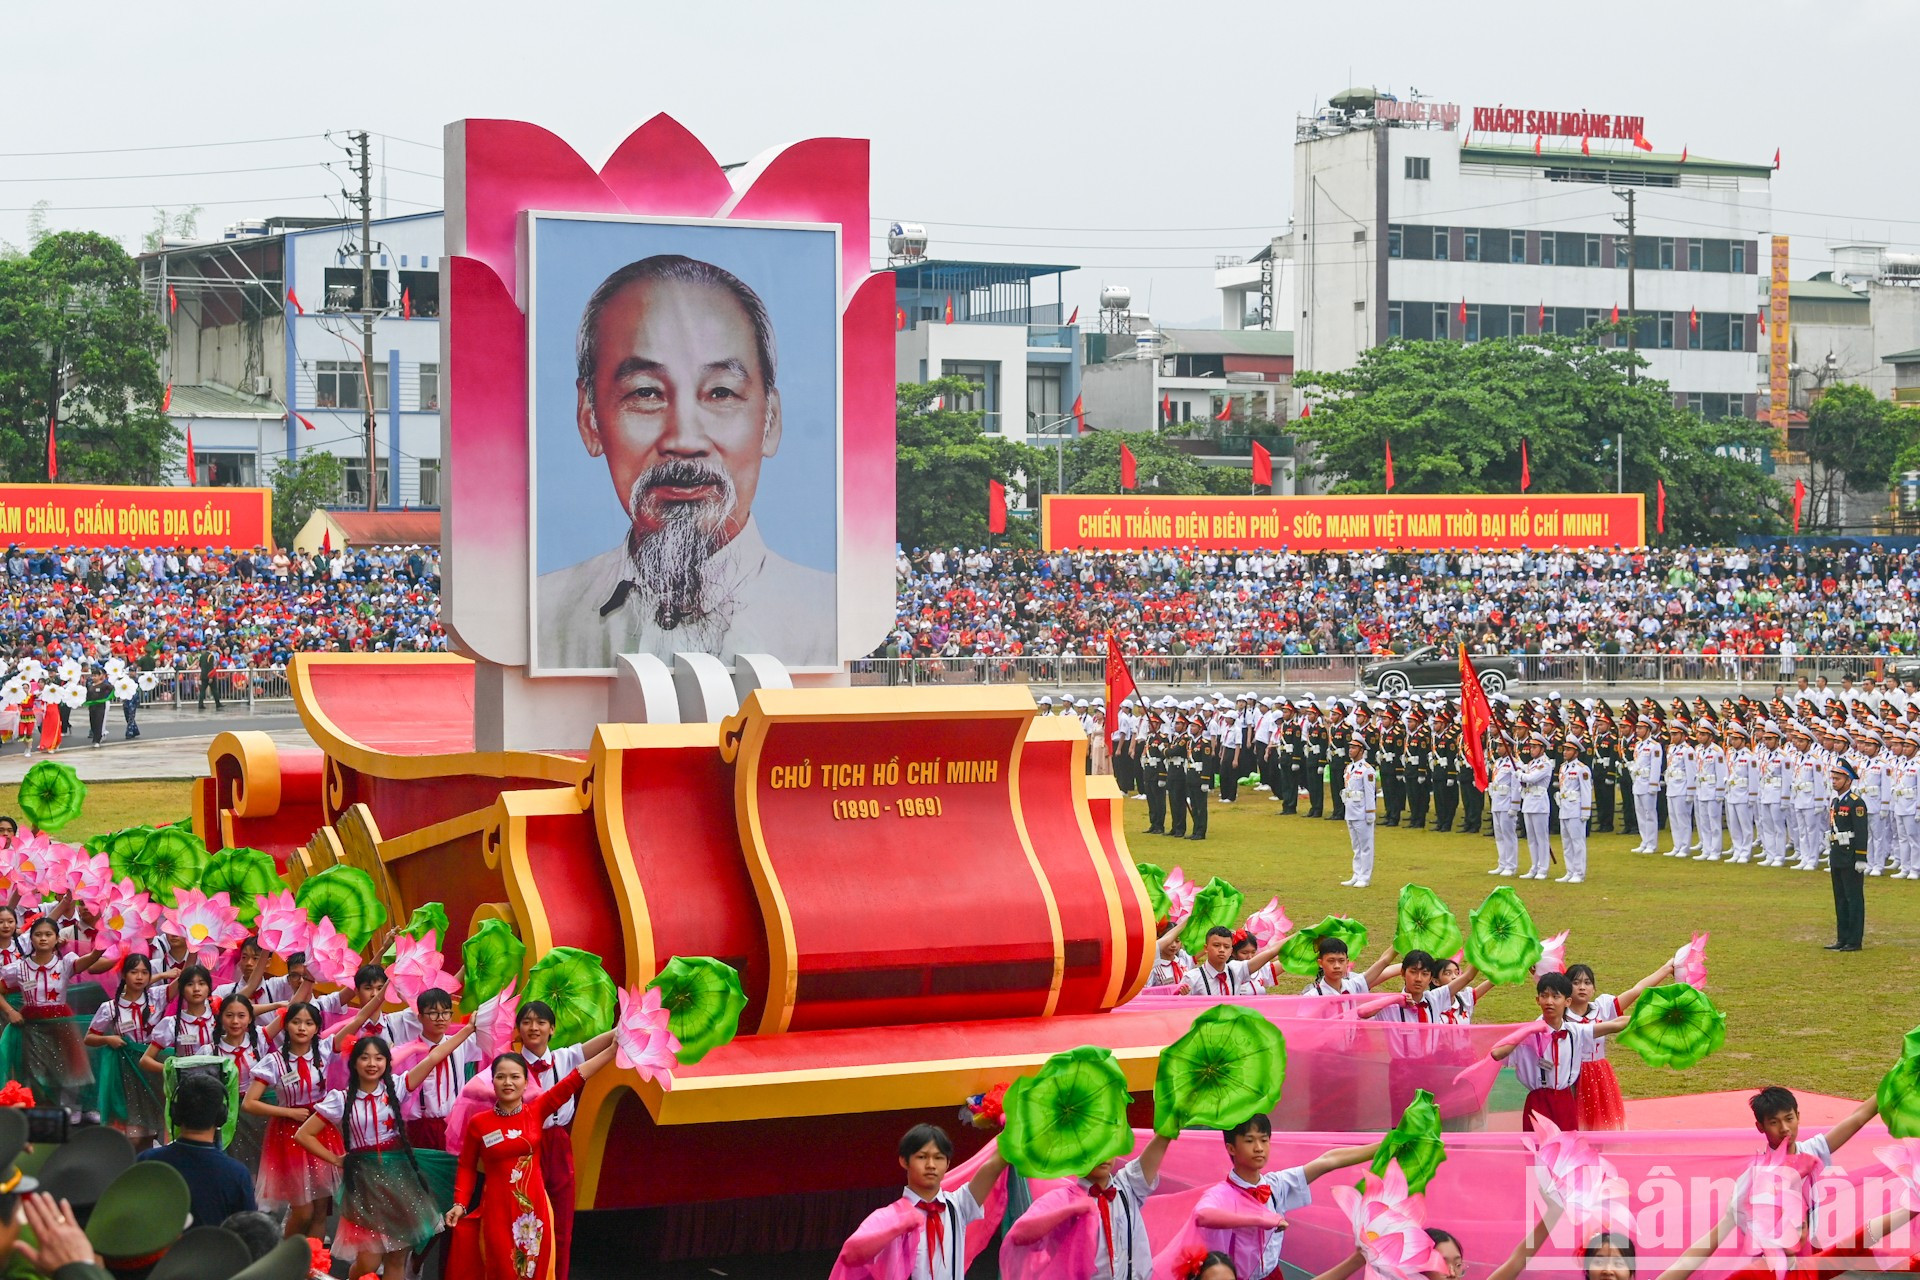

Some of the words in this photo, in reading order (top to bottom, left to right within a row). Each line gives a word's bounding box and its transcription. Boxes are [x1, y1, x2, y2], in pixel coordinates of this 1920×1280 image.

[1429, 103, 1461, 123] ANH
[1473, 103, 1524, 133] KHÁCH
[1560, 108, 1611, 138] HOÀNG
[1613, 115, 1644, 139] ANH
[25, 501, 70, 537] CHÂU,
[74, 499, 115, 535] CHẤN
[118, 503, 159, 541] ĐỘNG
[163, 509, 189, 541] ĐỊA
[1078, 507, 1121, 538] CHIẾN
[1125, 506, 1172, 538] THẮNG
[1175, 511, 1209, 543] ĐIỆN
[1213, 511, 1247, 538] BIÊN
[1250, 507, 1279, 538] PHỦ
[1293, 510, 1322, 538] SỨC
[1326, 514, 1370, 542] MẠNH
[1373, 510, 1403, 542] VIỆT
[1407, 514, 1441, 537] NAM
[1445, 508, 1477, 537] THỜI
[1481, 513, 1506, 542] ĐẠI
[1510, 506, 1529, 537] HỒ
[1534, 509, 1559, 537] CHÍ
[770, 758, 812, 789] CHỦ
[821, 763, 865, 791] TỊCH
[872, 755, 900, 786] HỒ
[906, 756, 941, 785] CHÍ
[946, 760, 999, 784] MINH
[832, 799, 880, 820] (1890
[896, 795, 942, 817] 1969)
